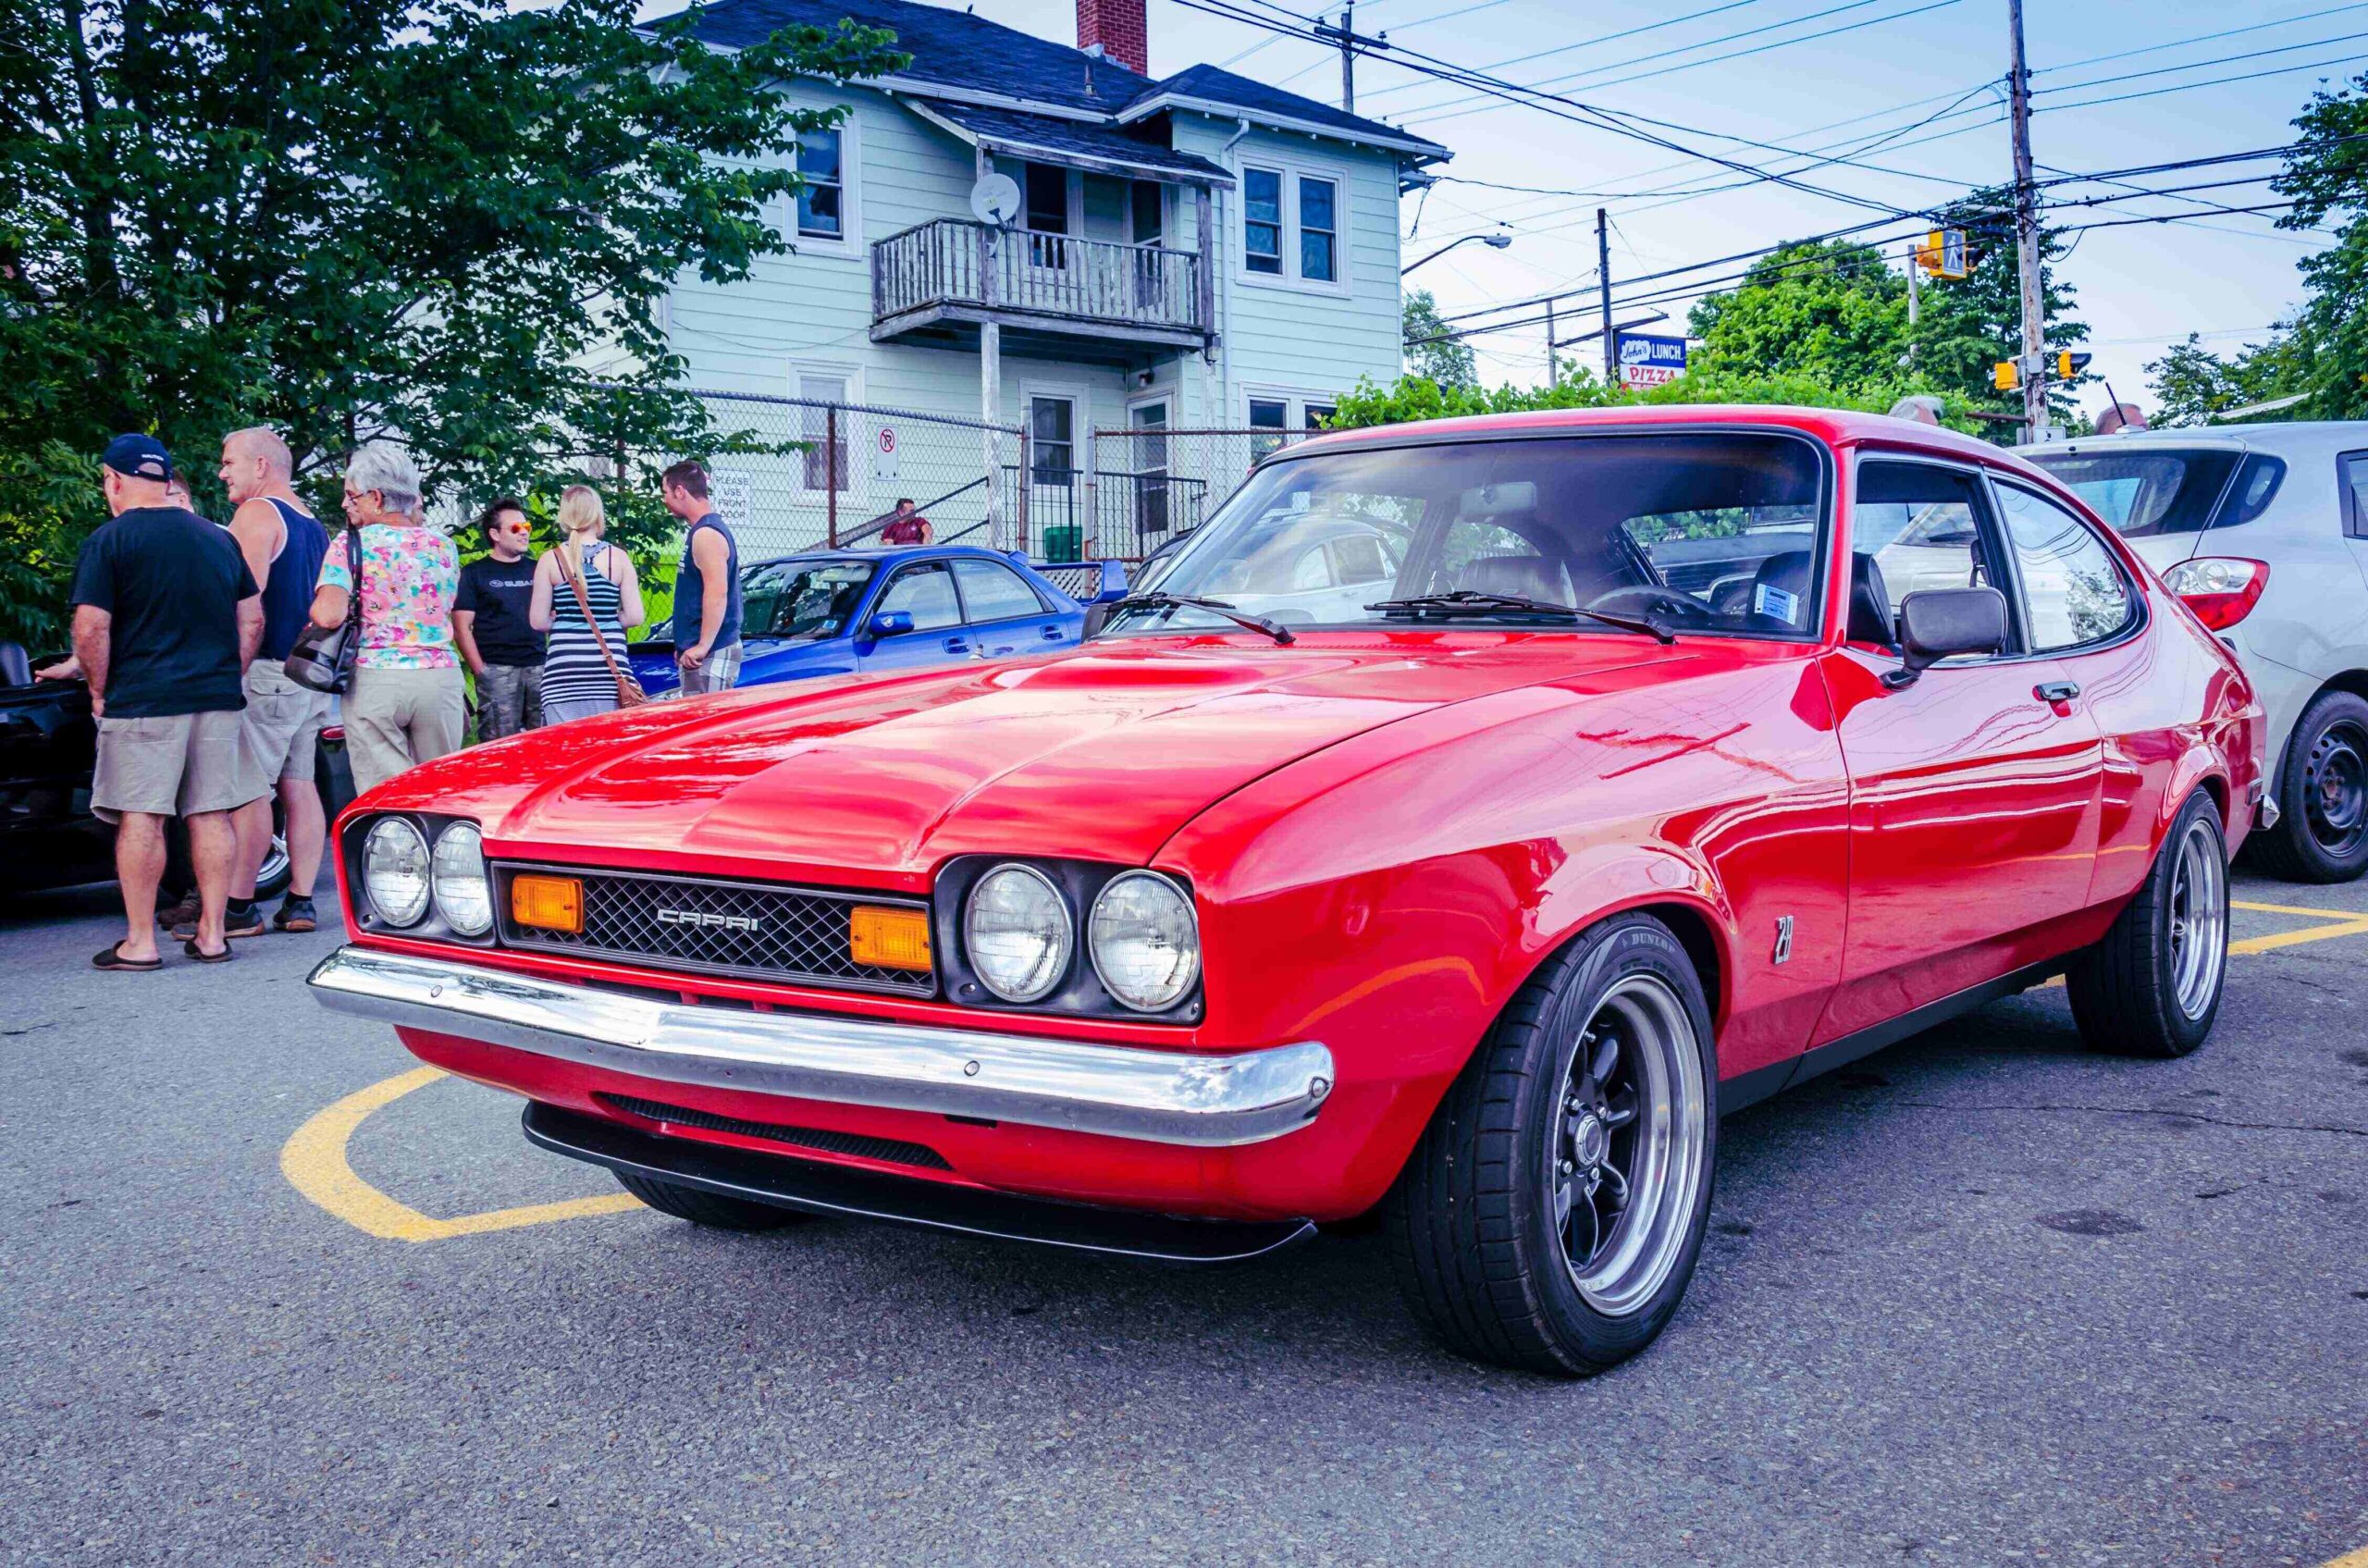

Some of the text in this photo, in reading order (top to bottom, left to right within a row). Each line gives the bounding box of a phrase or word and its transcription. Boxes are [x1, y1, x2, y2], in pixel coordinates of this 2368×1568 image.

[1623, 343, 1682, 361] John's LUNCH
[1629, 366, 1675, 383] PIZZA
[715, 475, 749, 486] PLEASE
[723, 488, 742, 497] USE
[718, 499, 746, 508] FRONT
[720, 510, 746, 519] DOOR
[657, 908, 758, 932] CAPRI
[1631, 932, 1675, 954] DUNLOP
